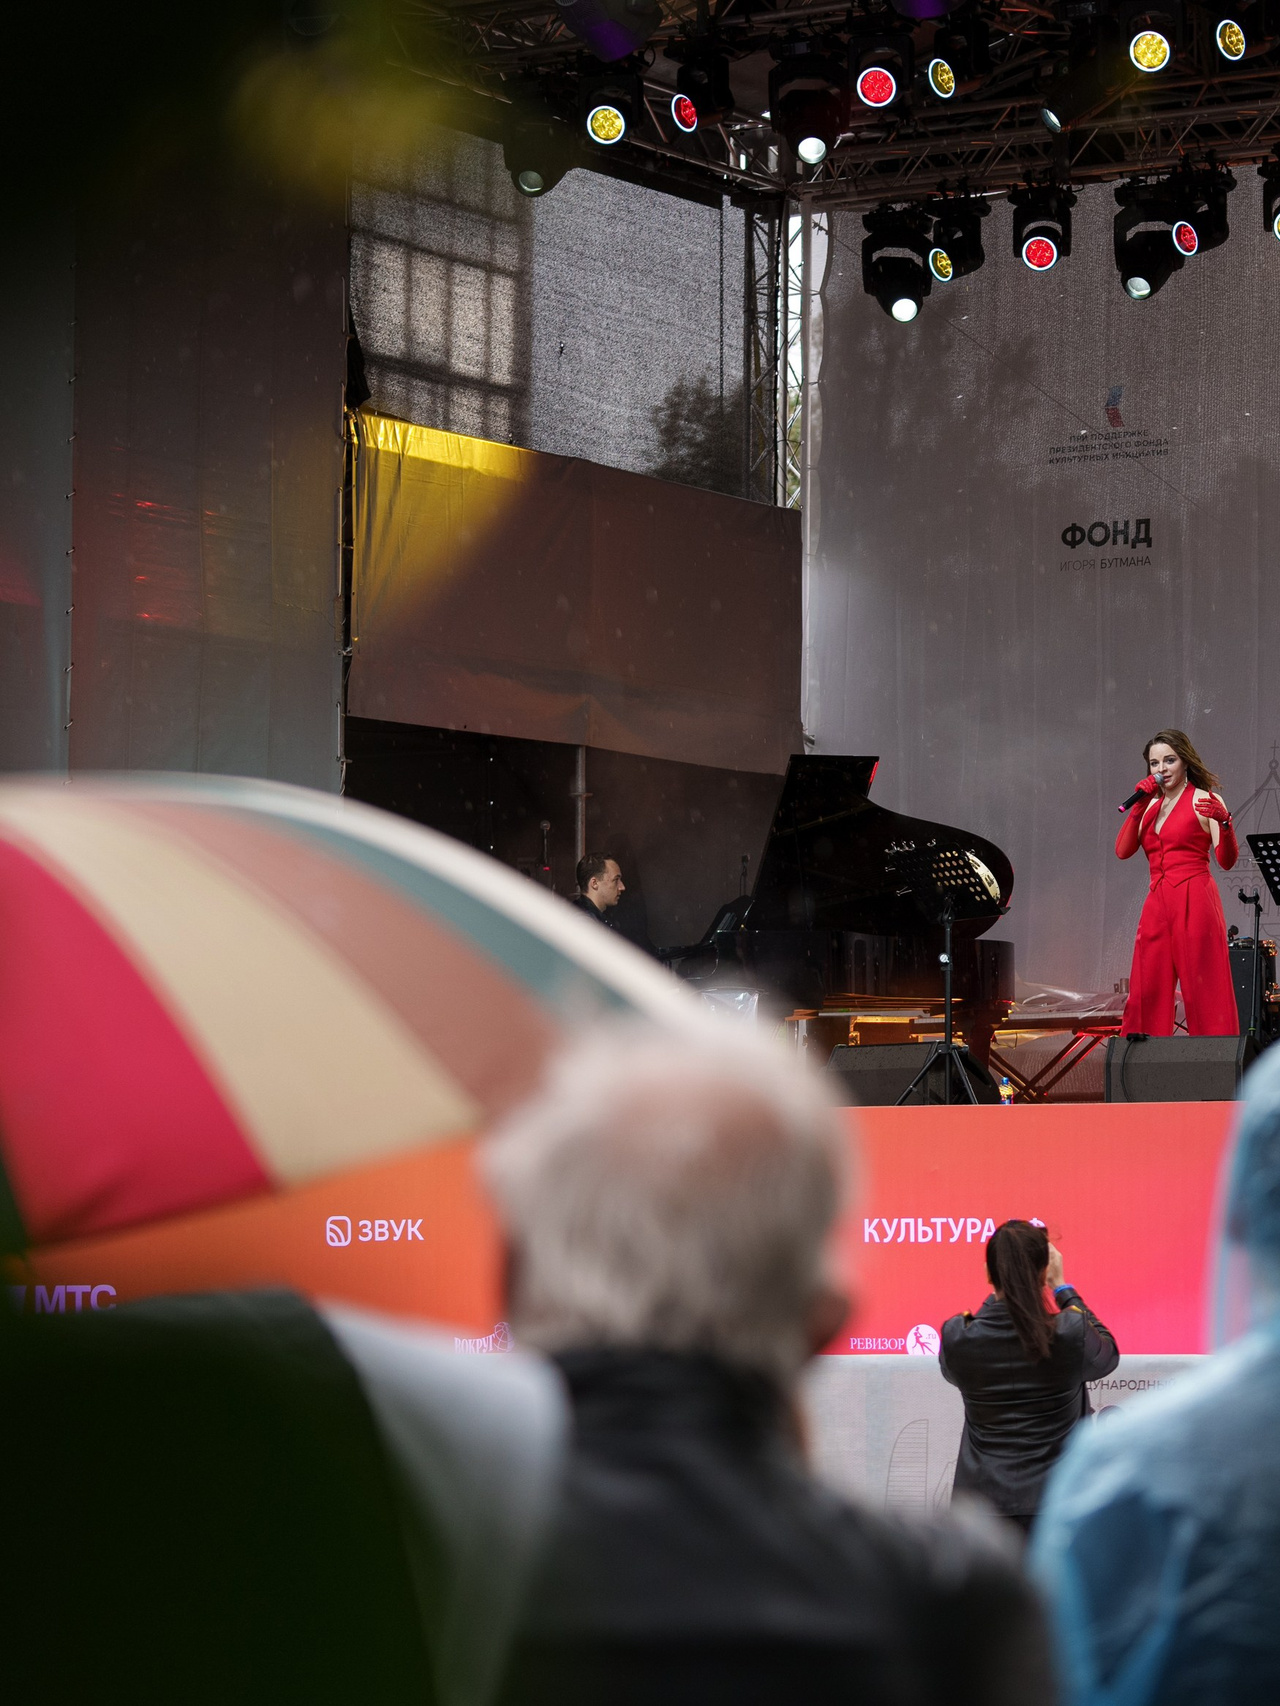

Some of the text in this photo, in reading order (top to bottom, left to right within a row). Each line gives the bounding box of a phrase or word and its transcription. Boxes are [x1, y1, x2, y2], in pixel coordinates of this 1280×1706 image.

[1069, 429, 1149, 443] ПРИ ПОДДЕРЖКЕ
[1134, 437, 1169, 448] ФОНДА
[1049, 453, 1110, 464] КУЛЬТУРНЫХ
[1061, 518, 1152, 549] ФОНД
[1060, 555, 1151, 571] ИГОРЯ БУТМАНА
[358, 1219, 424, 1242] ЗВУК
[850, 1337, 905, 1350] РЕВИЗОР
